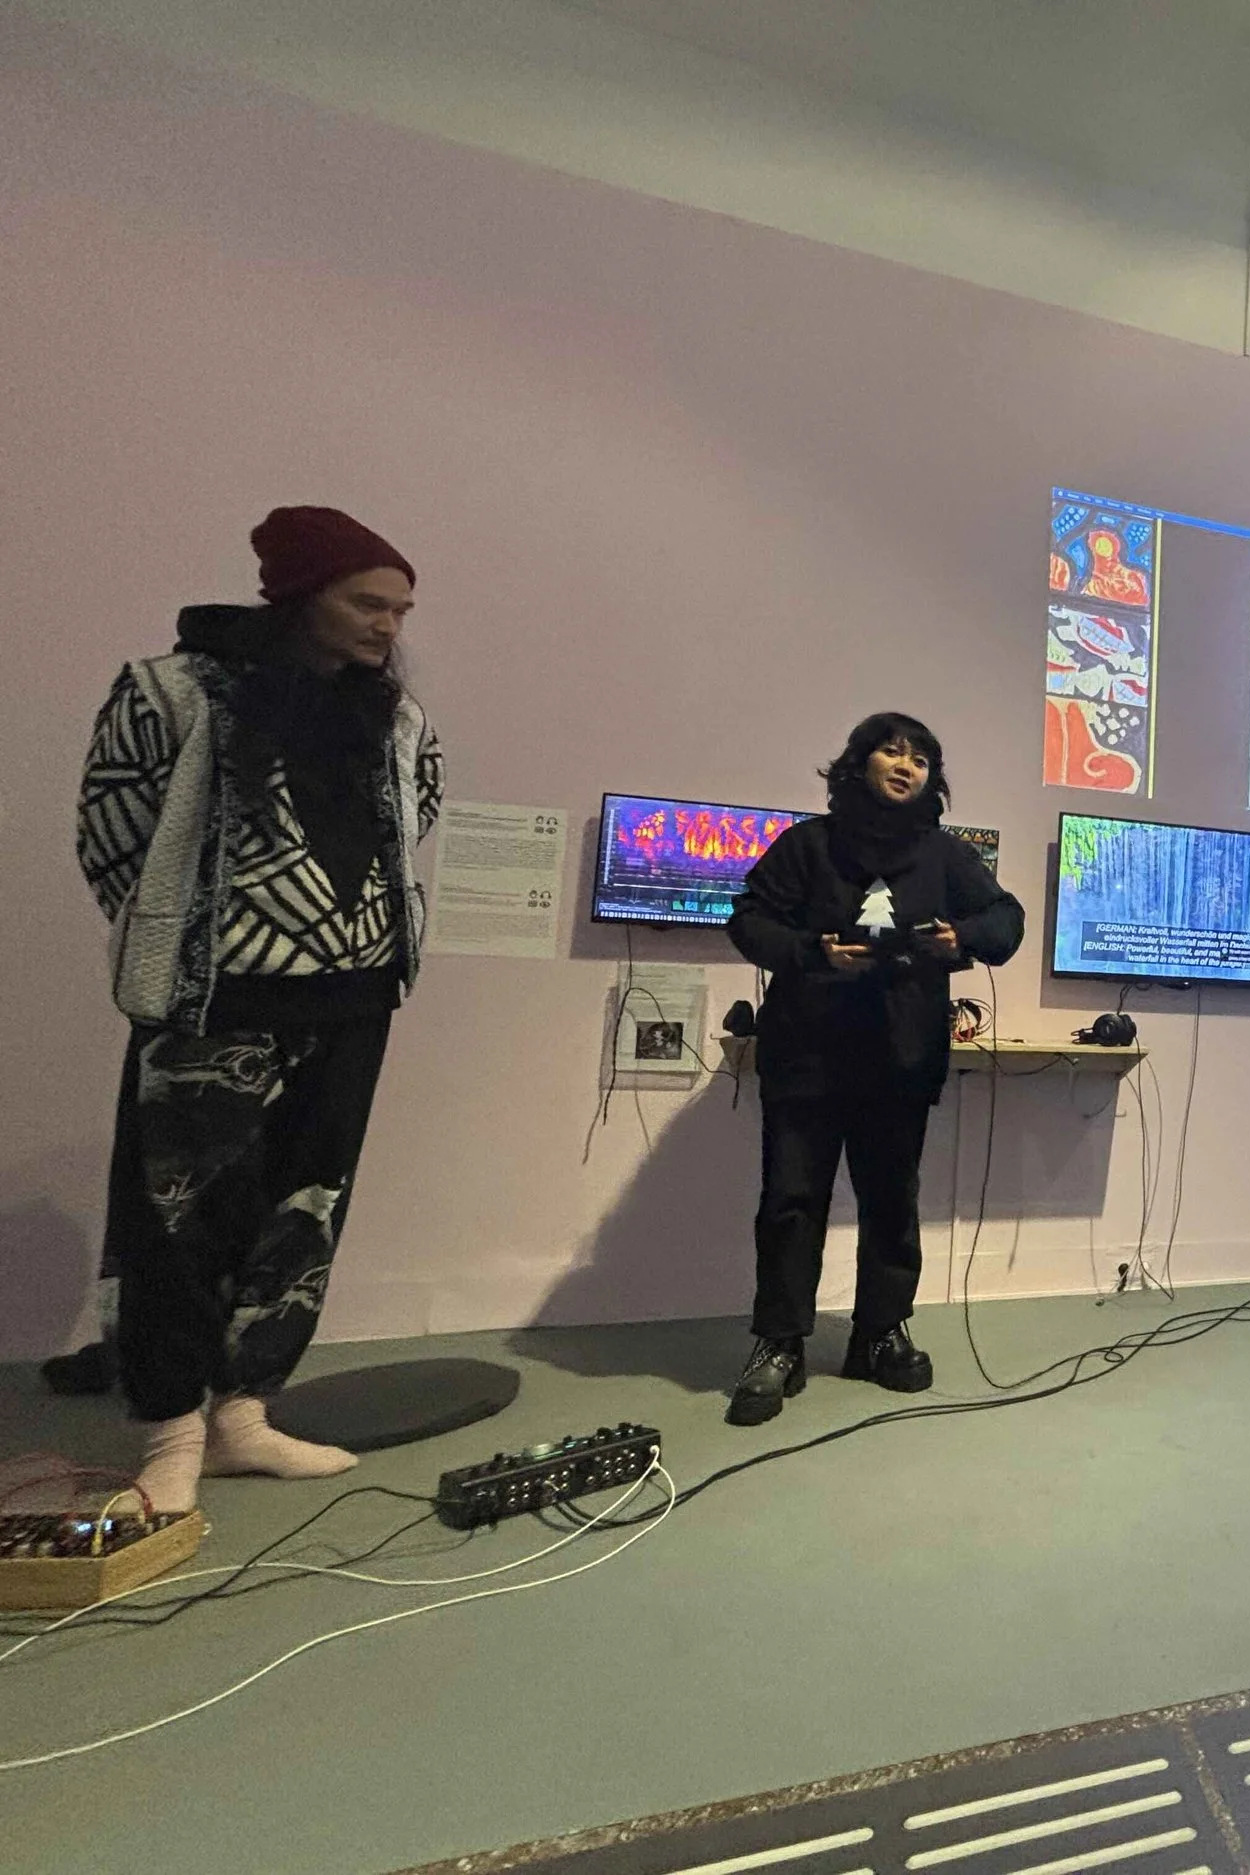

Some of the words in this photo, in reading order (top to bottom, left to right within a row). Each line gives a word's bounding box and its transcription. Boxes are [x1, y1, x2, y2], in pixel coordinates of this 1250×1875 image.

[1218, 932, 1231, 940] und
[1194, 948, 1208, 956] and
[1128, 954, 1159, 963] waterfall
[1160, 955, 1166, 963] in
[1168, 955, 1179, 964] the
[1180, 957, 1199, 965] heart
[1200, 957, 1208, 966] of
[1209, 958, 1220, 966] the
